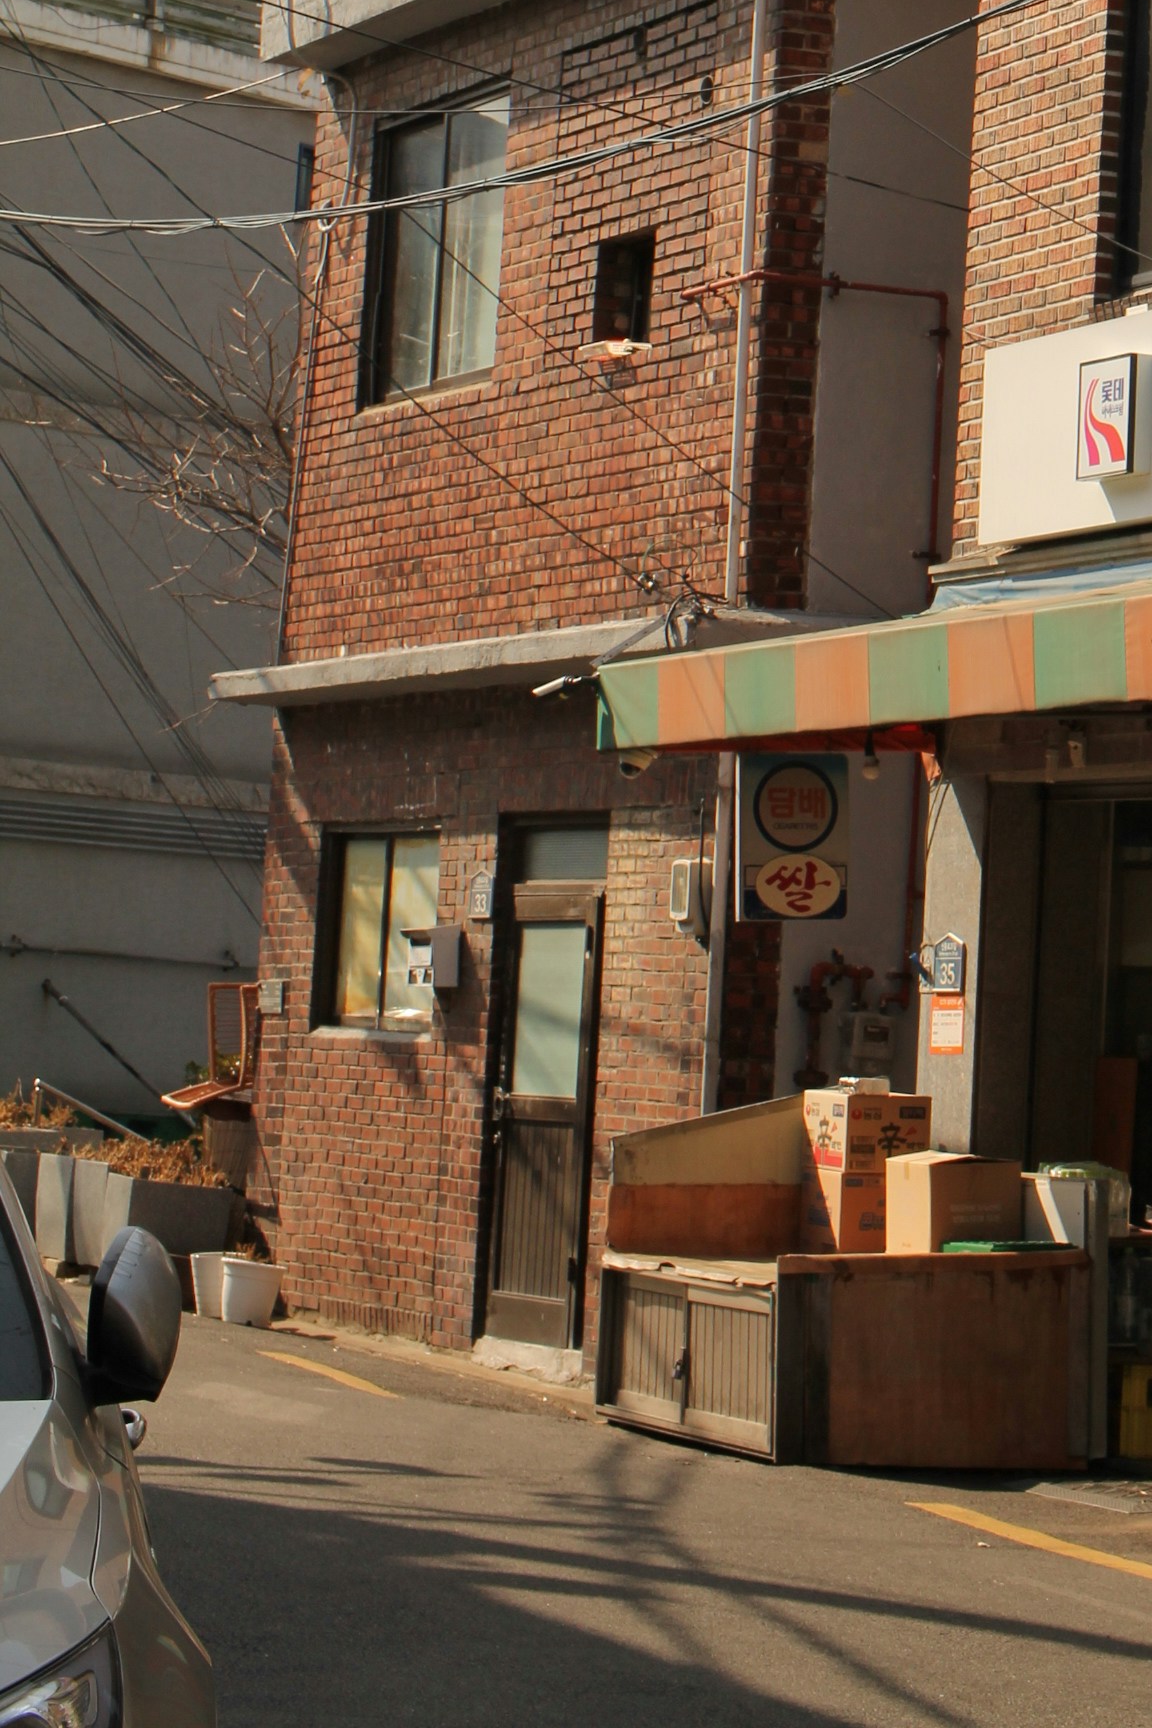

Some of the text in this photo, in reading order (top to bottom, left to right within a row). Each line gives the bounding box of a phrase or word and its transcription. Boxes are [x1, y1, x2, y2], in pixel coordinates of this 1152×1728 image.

[1101, 377, 1125, 404] 롯데
[767, 786, 827, 820] 담배
[764, 860, 832, 914] 쌀
[474, 893, 487, 913] 33
[939, 962, 955, 985] 35
